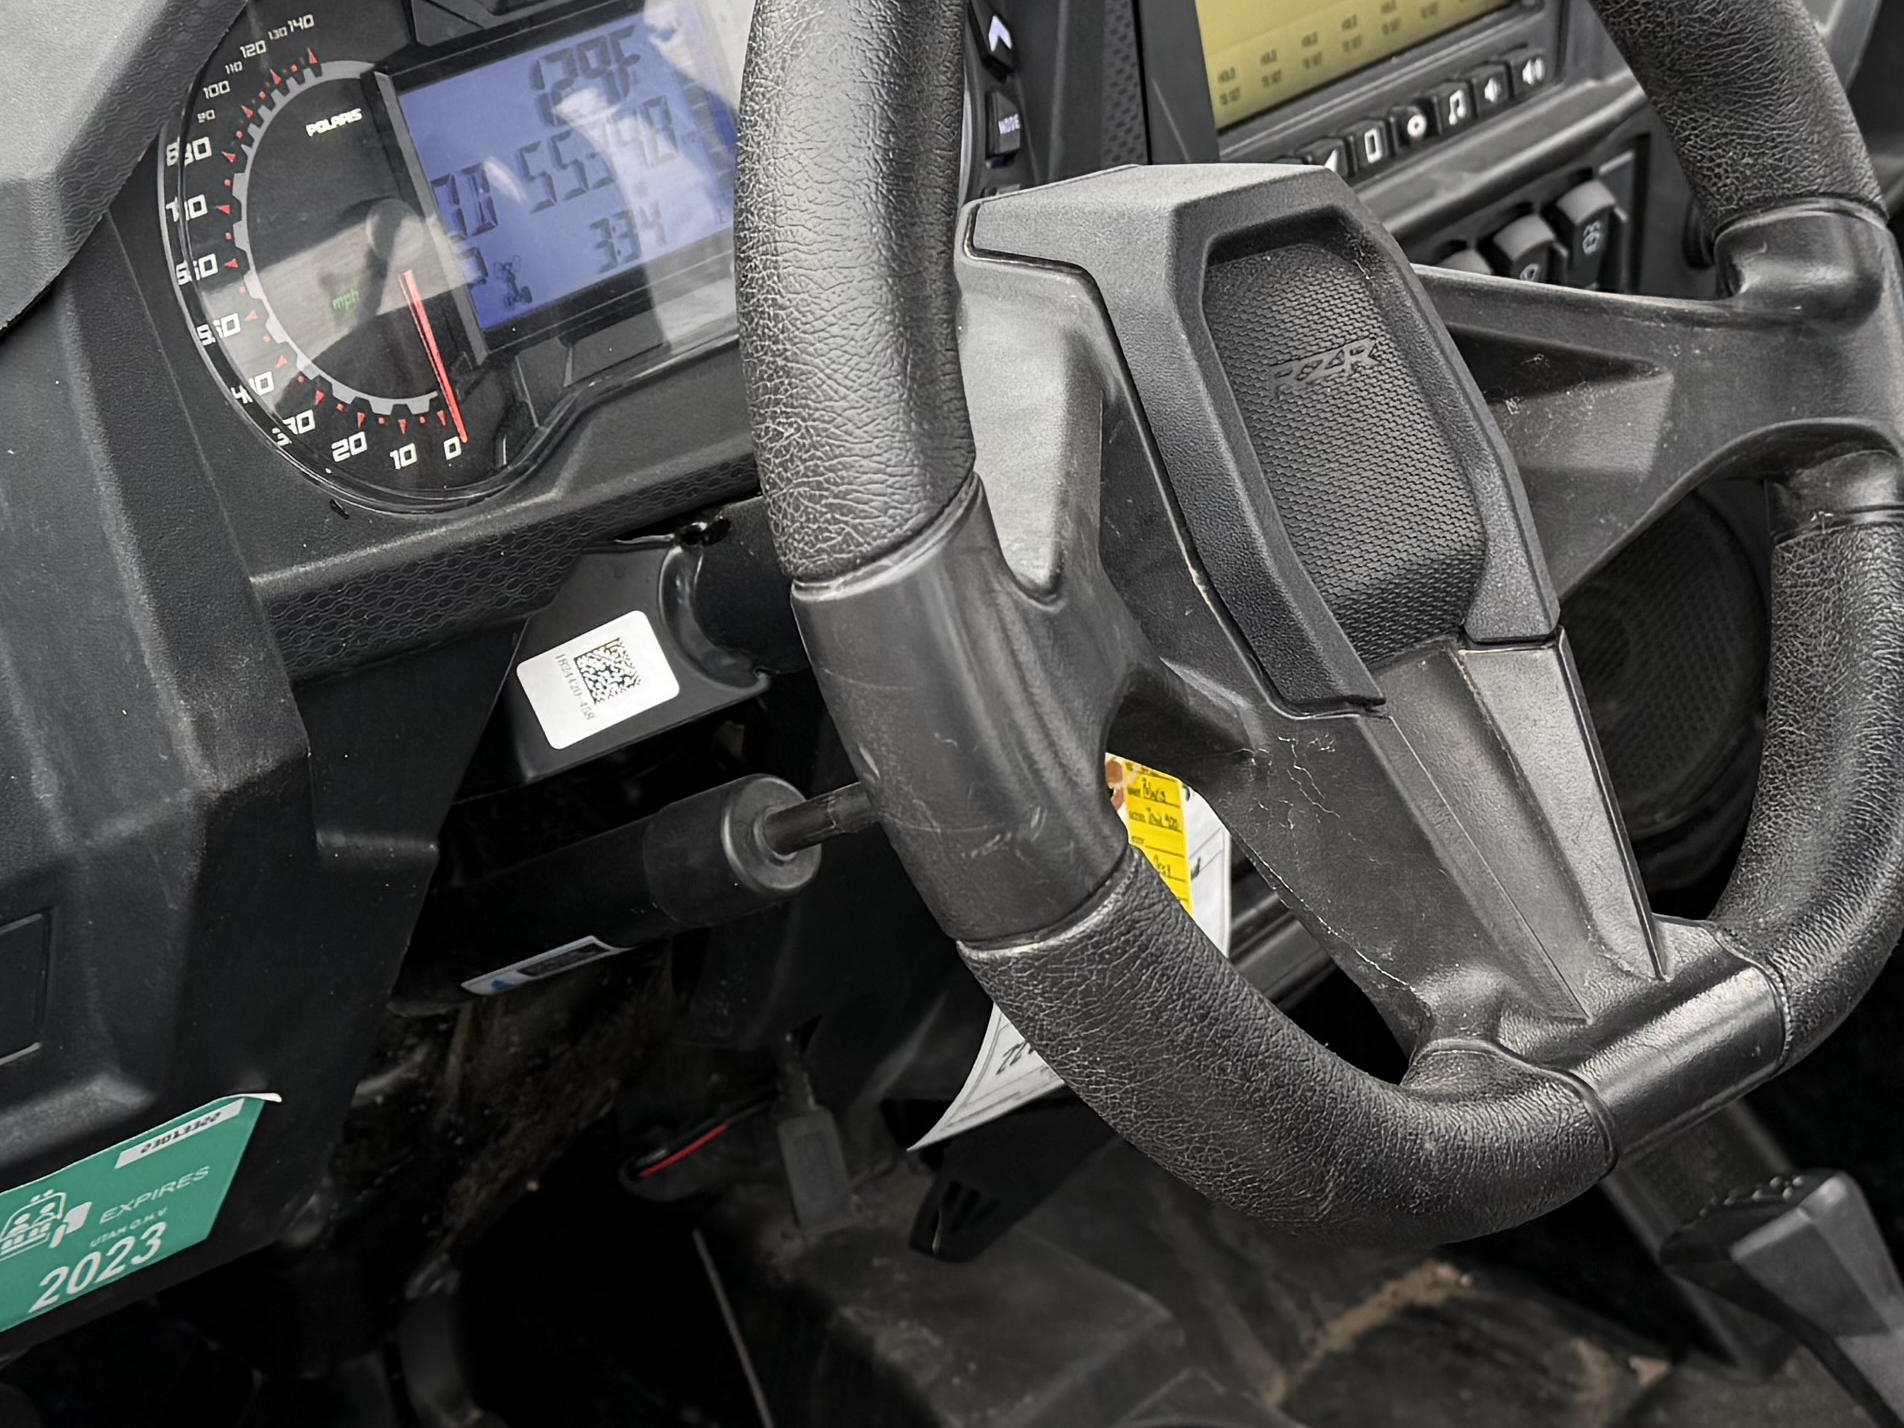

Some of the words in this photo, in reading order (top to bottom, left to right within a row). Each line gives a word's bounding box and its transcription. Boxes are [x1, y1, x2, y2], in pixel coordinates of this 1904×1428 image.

[267, 27, 288, 41] 130
[287, 14, 315, 33] 140
[240, 40, 267, 59] 120
[224, 60, 243, 75] 110
[202, 80, 231, 100] 100
[306, 108, 363, 137] POLARIS
[332, 289, 360, 313] mph
[331, 431, 367, 463] 20
[390, 442, 417, 469] 10
[443, 436, 462, 460] 0
[99, 1165, 210, 1224] EXPIRES
[28, 1222, 168, 1313] 2023
